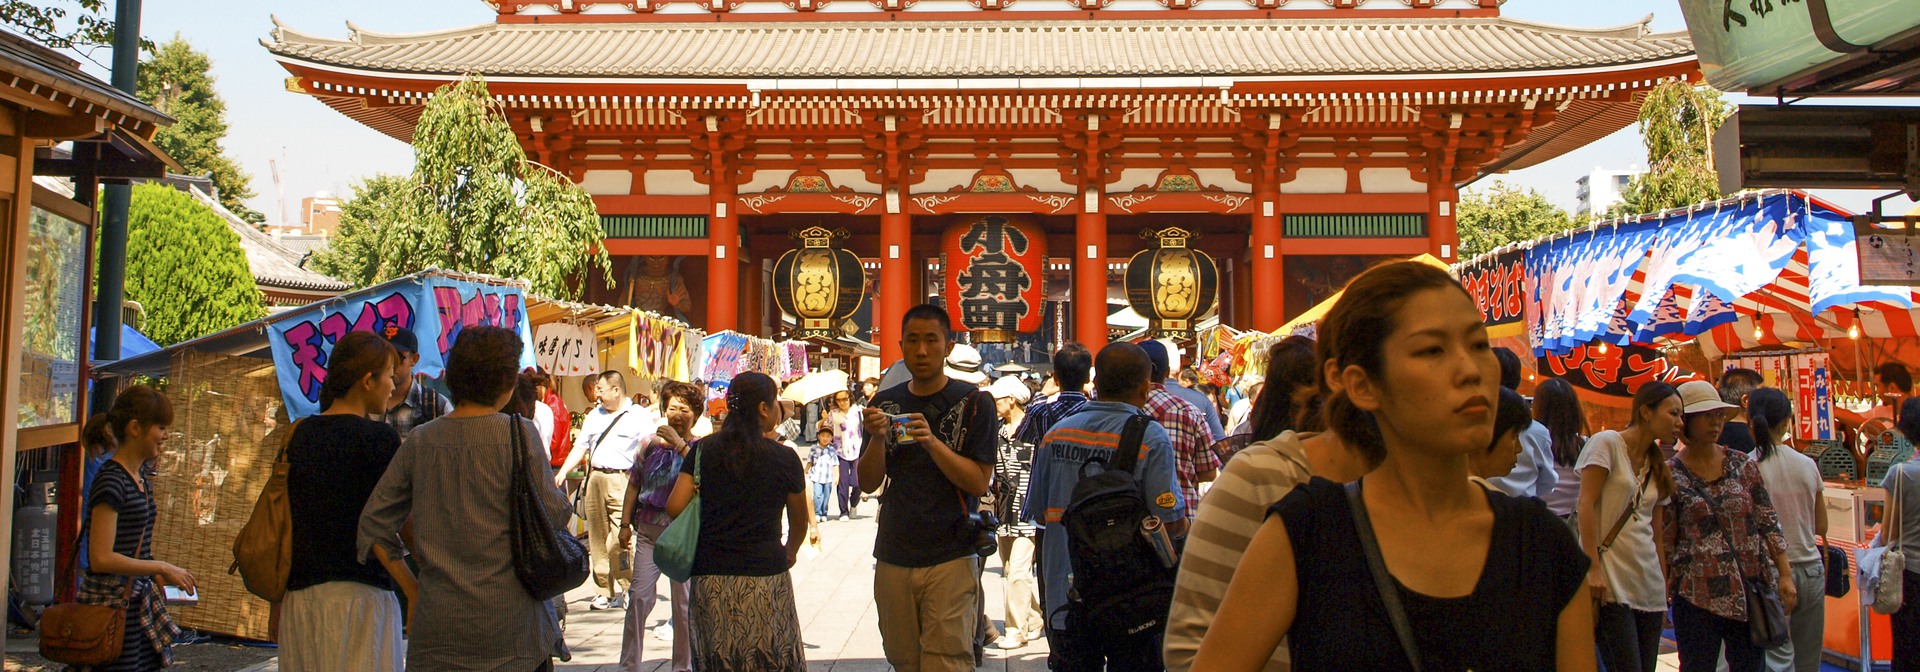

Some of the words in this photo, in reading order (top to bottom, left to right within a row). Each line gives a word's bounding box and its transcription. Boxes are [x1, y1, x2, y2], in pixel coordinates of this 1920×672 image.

[957, 216, 1032, 331] 小舟町
[1800, 375, 1812, 433] コーラ
[1816, 375, 1829, 431] みぞれ
